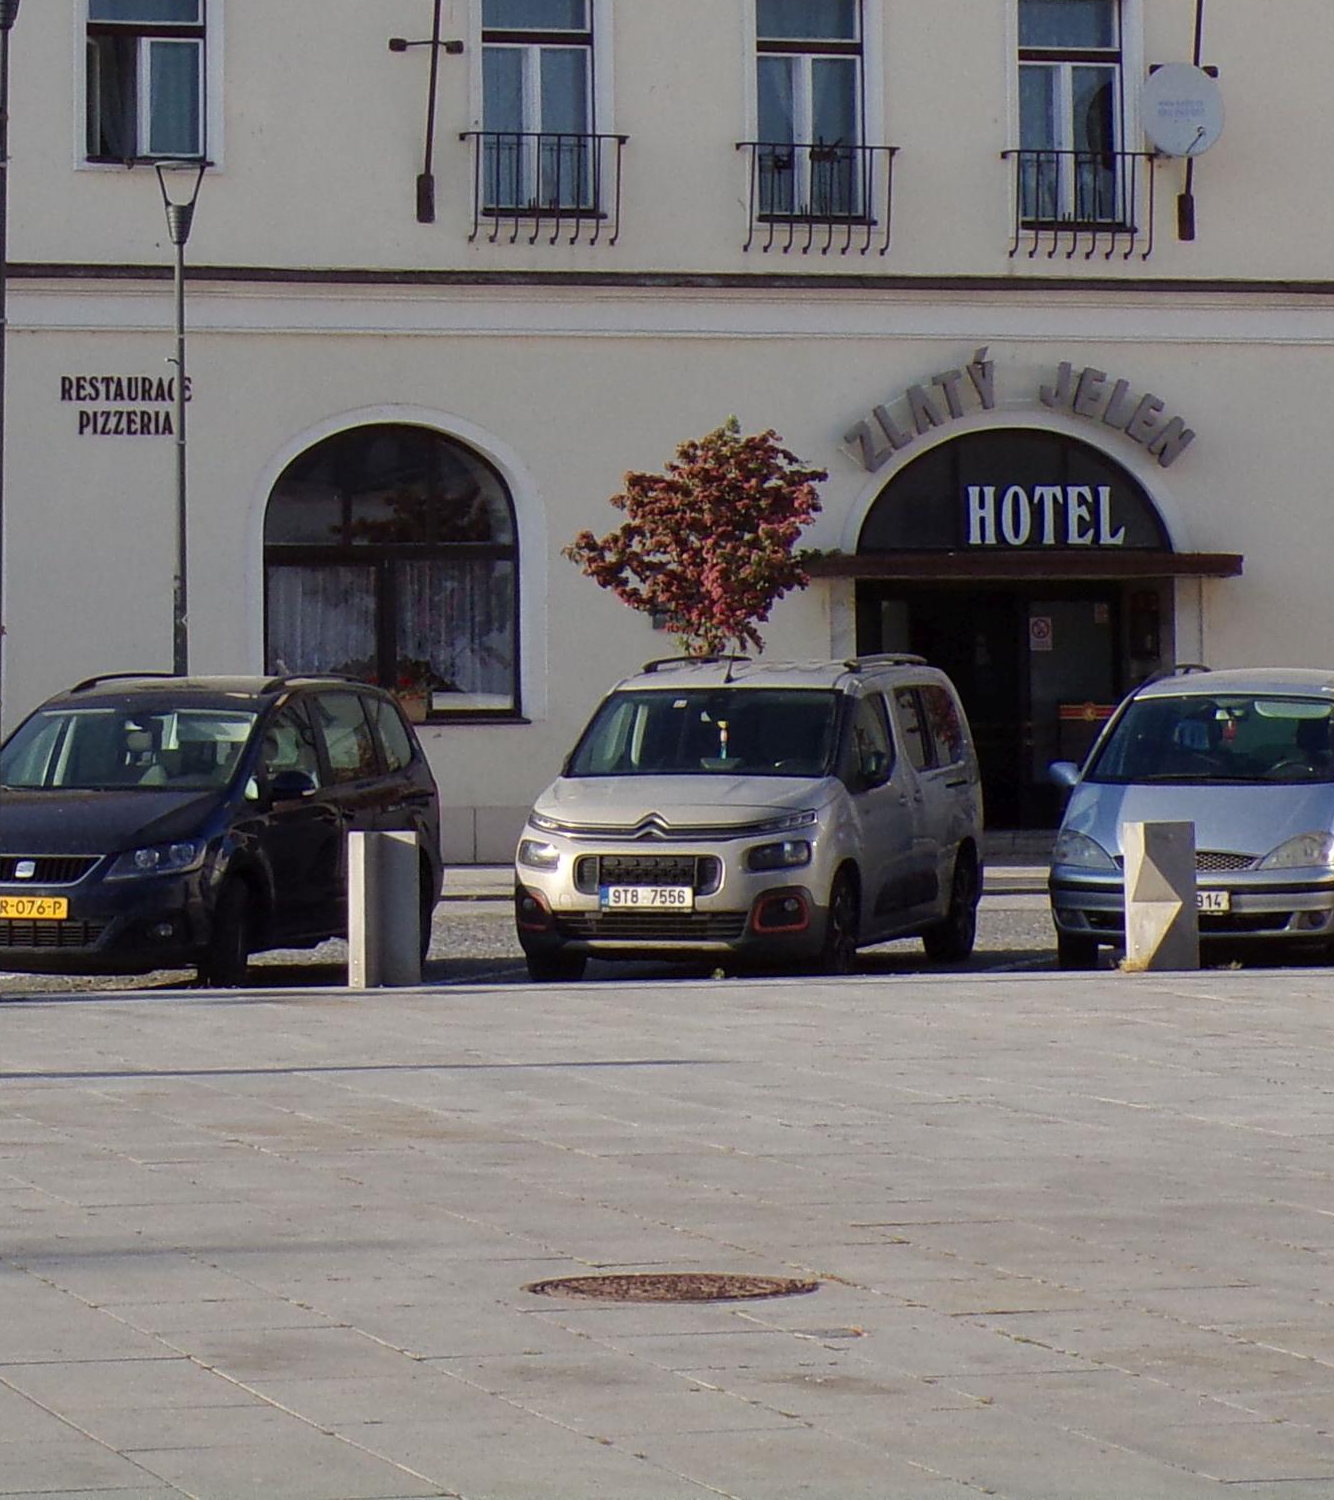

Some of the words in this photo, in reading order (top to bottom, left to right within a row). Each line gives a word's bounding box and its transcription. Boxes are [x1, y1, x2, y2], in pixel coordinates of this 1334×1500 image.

[844, 346, 995, 473] ZLATÝ
[1040, 361, 1196, 468] JELEN
[78, 410, 174, 435] PIZZERIA
[967, 485, 1126, 545] HOTEL
[612, 889, 639, 904] 9T8
[650, 889, 686, 904] 7556
[1195, 893, 1222, 909] 914
